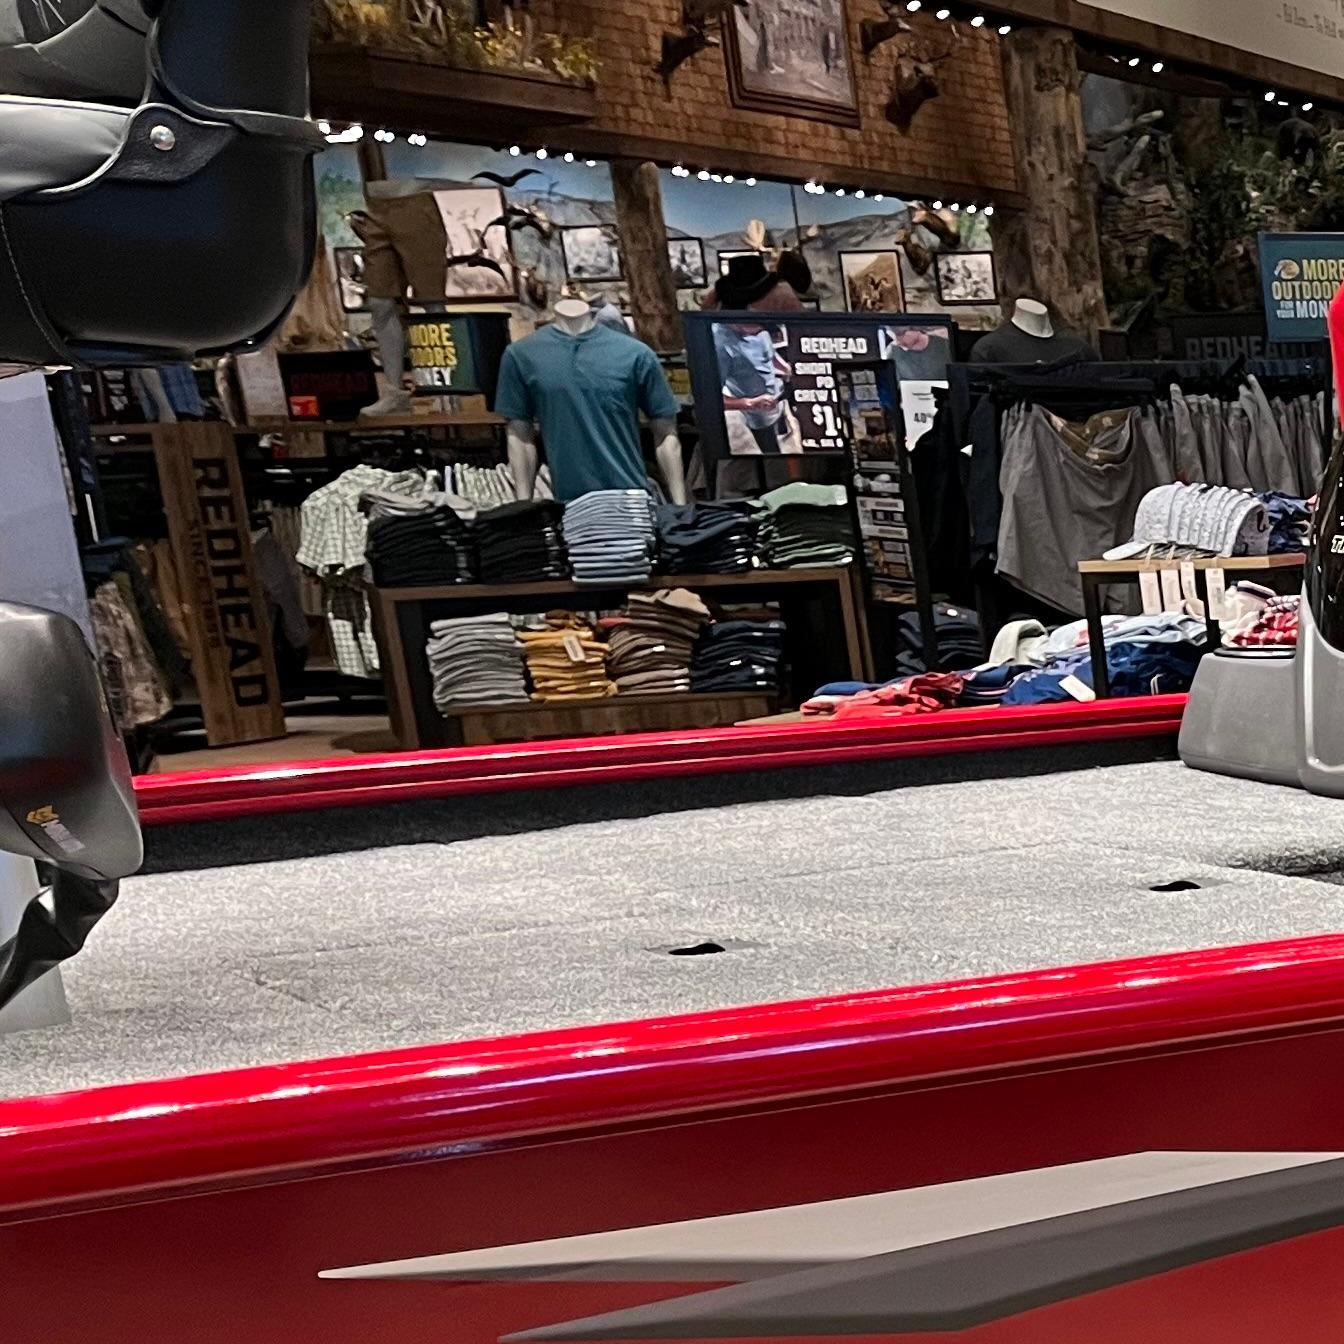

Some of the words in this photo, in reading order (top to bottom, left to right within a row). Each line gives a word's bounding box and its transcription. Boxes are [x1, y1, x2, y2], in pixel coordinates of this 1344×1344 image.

[1271, 281, 1341, 300] OUTDOOR
[1296, 300, 1331, 319] MON
[800, 337, 867, 354] REDHEAD
[192, 457, 269, 708] REDHEAD
